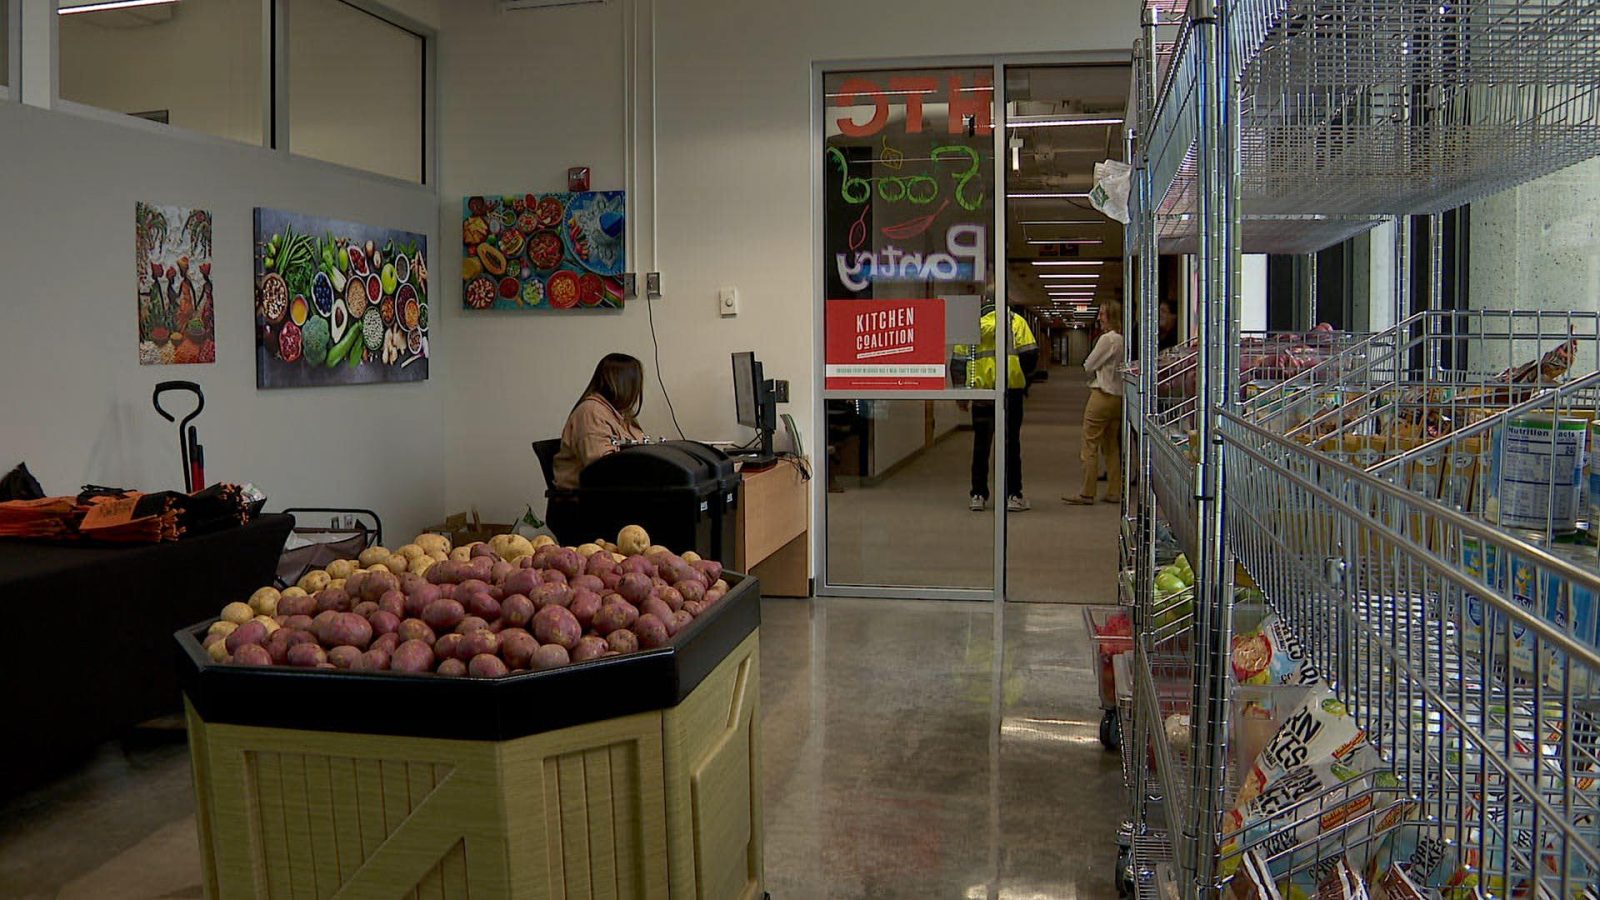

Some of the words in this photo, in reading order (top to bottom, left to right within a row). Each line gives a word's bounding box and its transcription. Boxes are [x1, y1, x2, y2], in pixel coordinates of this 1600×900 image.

[856, 307, 914, 333] KITCHEN
[856, 328, 914, 350] COALITION
[1508, 426, 1549, 438] Nutrition
